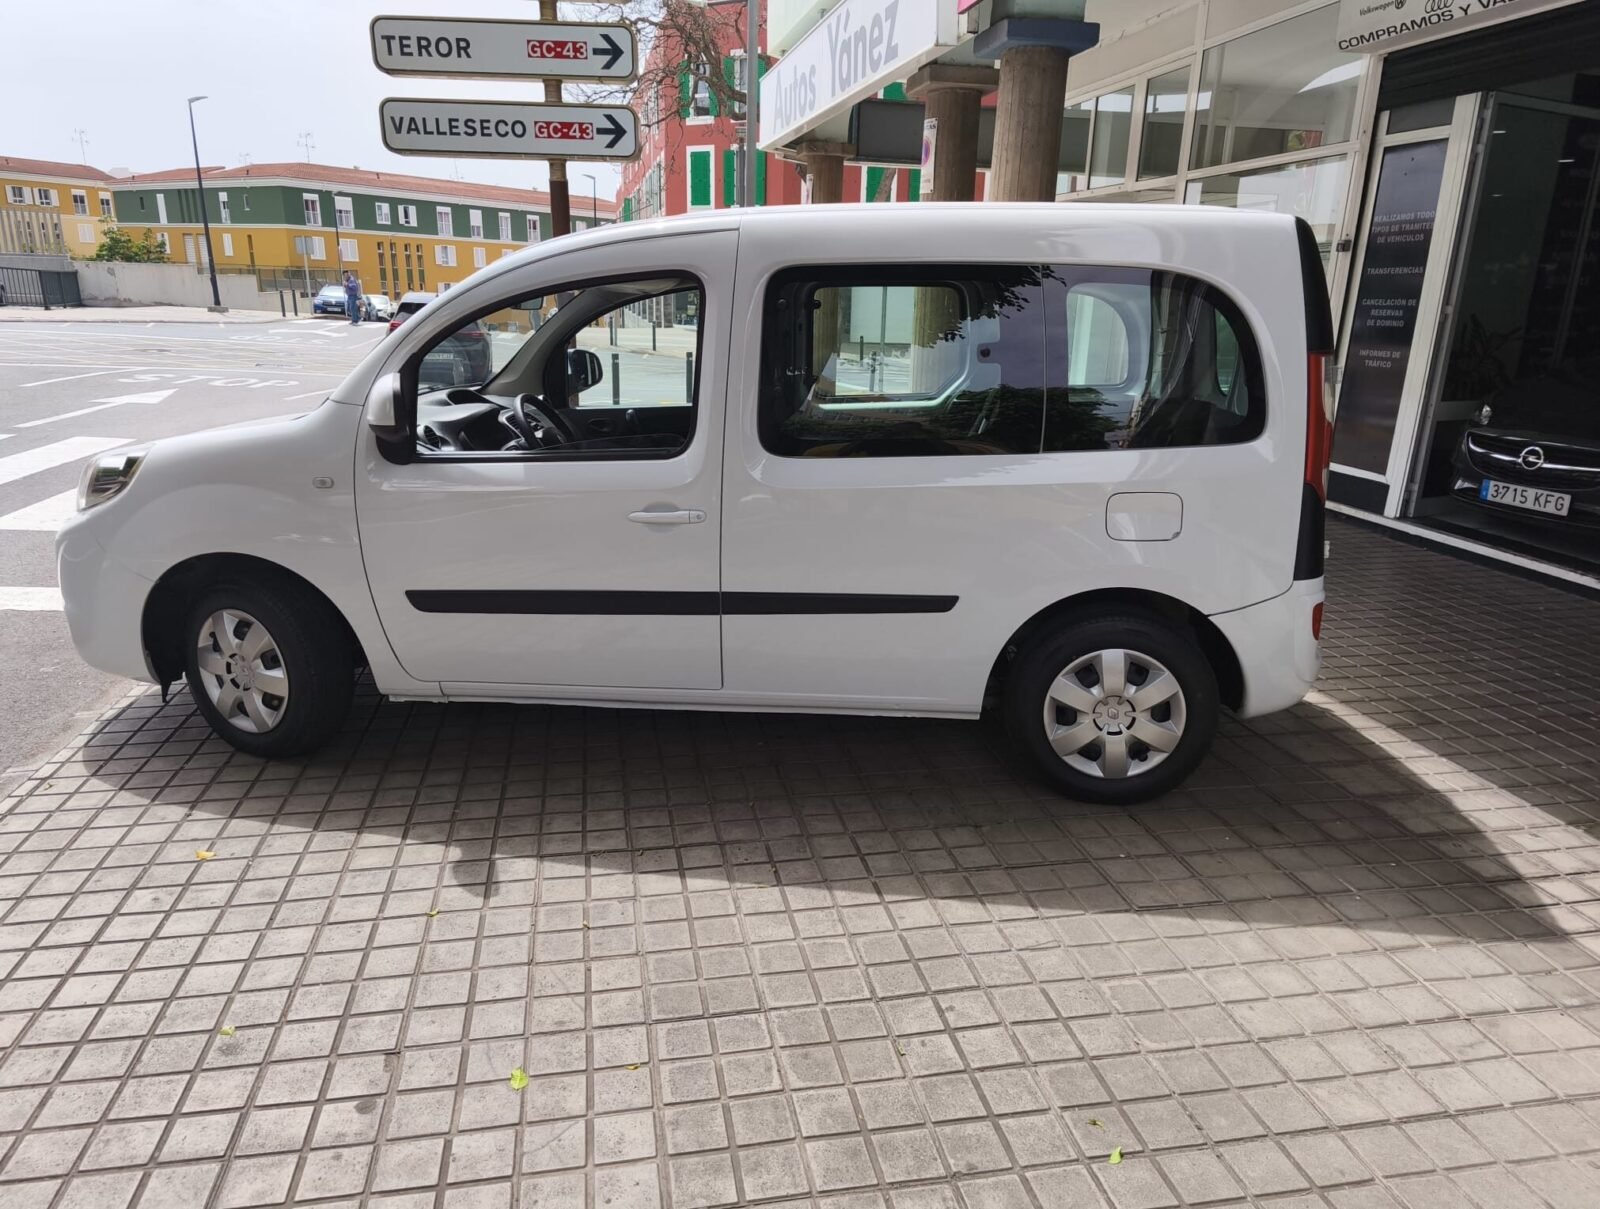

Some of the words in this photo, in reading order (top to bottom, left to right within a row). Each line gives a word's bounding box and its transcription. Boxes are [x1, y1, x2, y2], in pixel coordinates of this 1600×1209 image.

[1338, 10, 1454, 50] COMPRAMOS
[1458, 3, 1471, 16] Y
[380, 34, 472, 59] TEROR
[527, 41, 588, 59] GC-43
[773, 64, 816, 134] Autos
[827, 0, 899, 98] Yánez
[389, 115, 527, 138] VALLESECO
[534, 122, 593, 139] GC-43
[1374, 213, 1414, 222] REALIZAMOS
[1391, 224, 1400, 232] DE
[1377, 235, 1386, 243] DE
[1407, 298, 1417, 306] DE
[1370, 309, 1403, 317] RESERVAS
[1366, 319, 1375, 327] DE
[1376, 319, 1405, 327] DOMINIO
[1360, 349, 1391, 358] INFORMES
[117, 374, 299, 388] STOP
[1490, 484, 1528, 505] 3715
[1532, 491, 1565, 512] KFG
